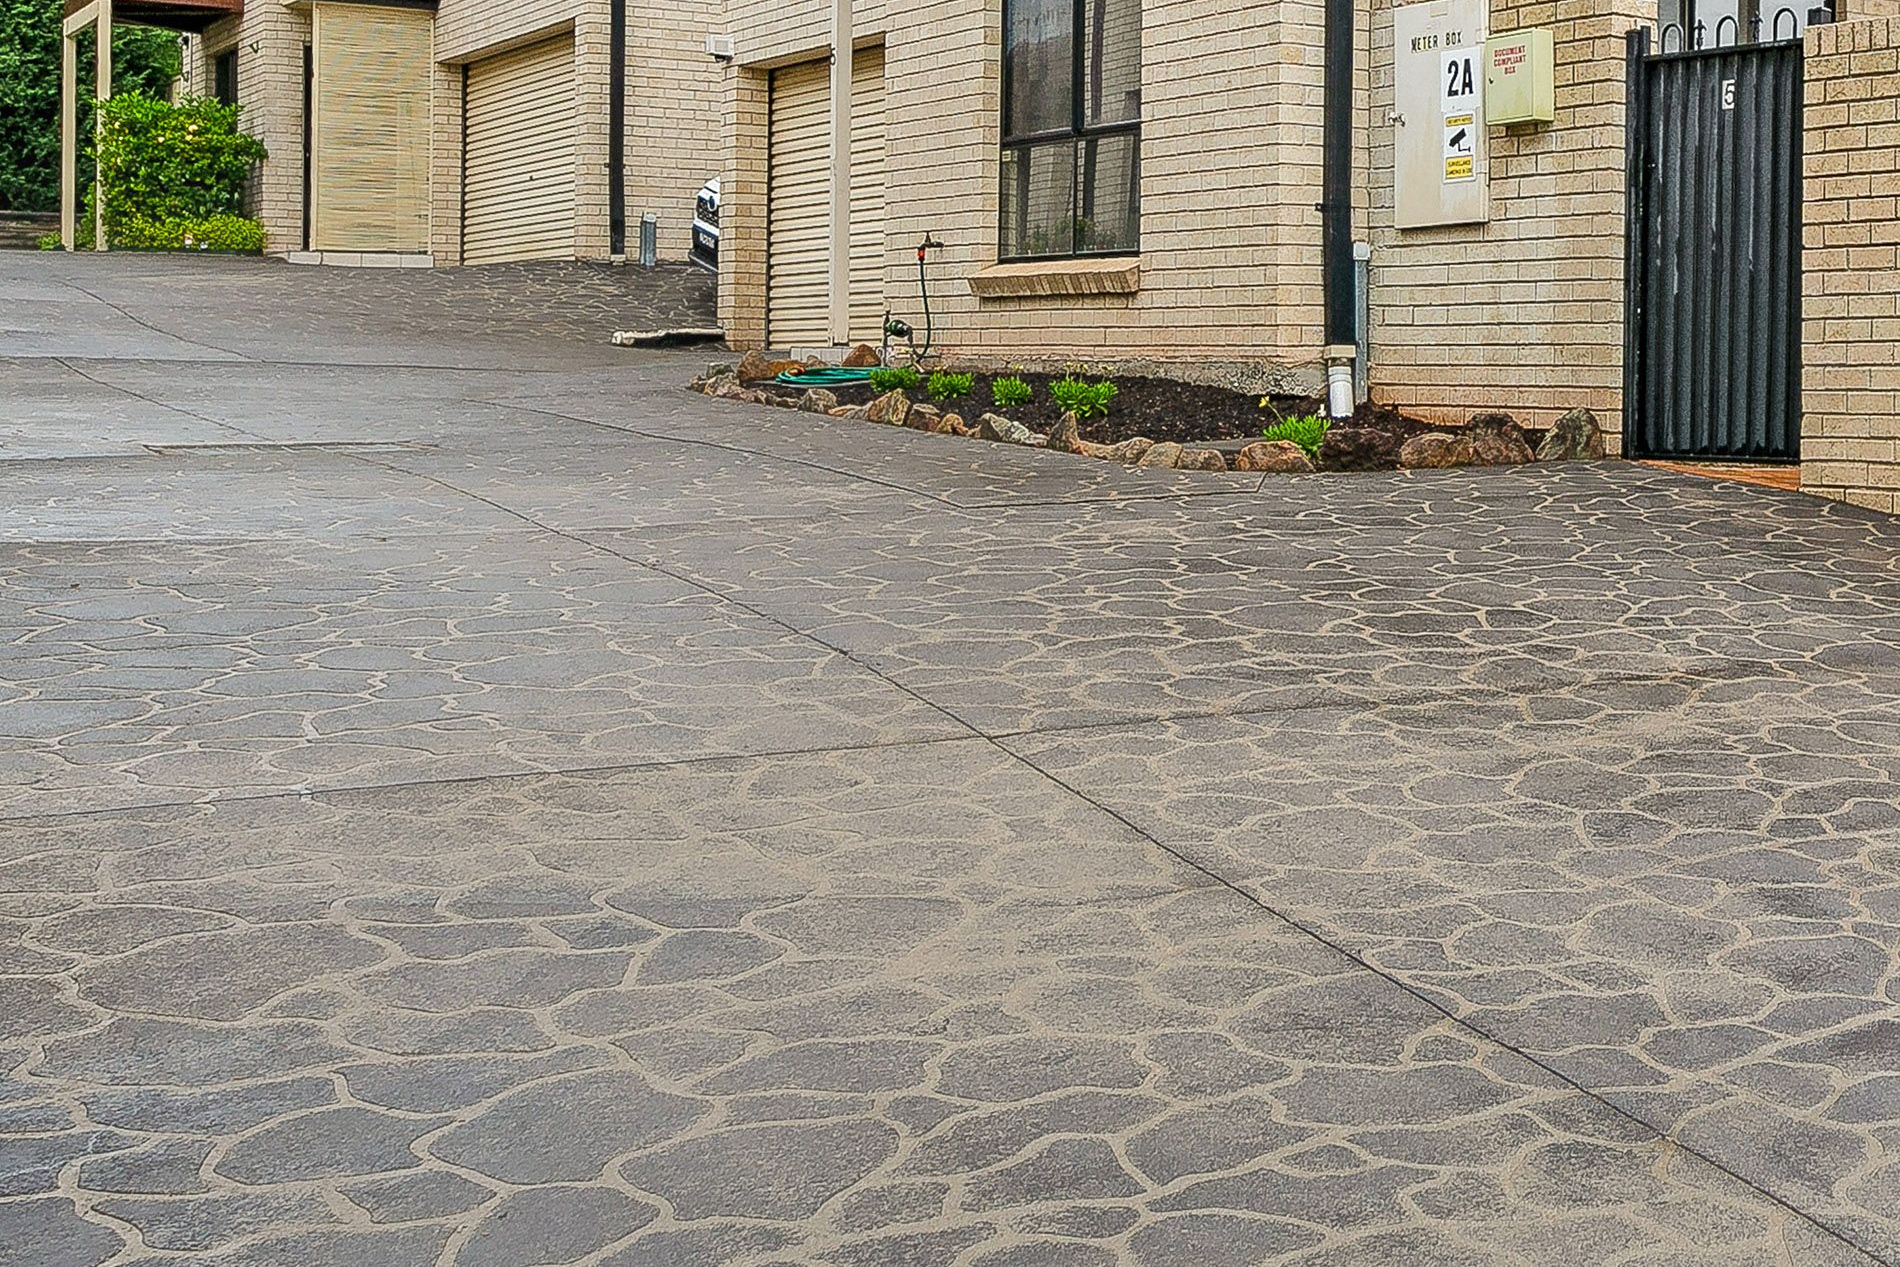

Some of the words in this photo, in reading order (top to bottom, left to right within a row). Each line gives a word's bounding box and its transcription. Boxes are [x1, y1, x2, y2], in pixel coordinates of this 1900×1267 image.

[1411, 35, 1438, 52] METER
[1446, 32, 1462, 46] BOX
[1494, 45, 1526, 58] DOCUMENT
[1494, 55, 1526, 67] COMPLIANT
[1504, 66, 1516, 75] BOX
[1447, 58, 1474, 97] 2A
